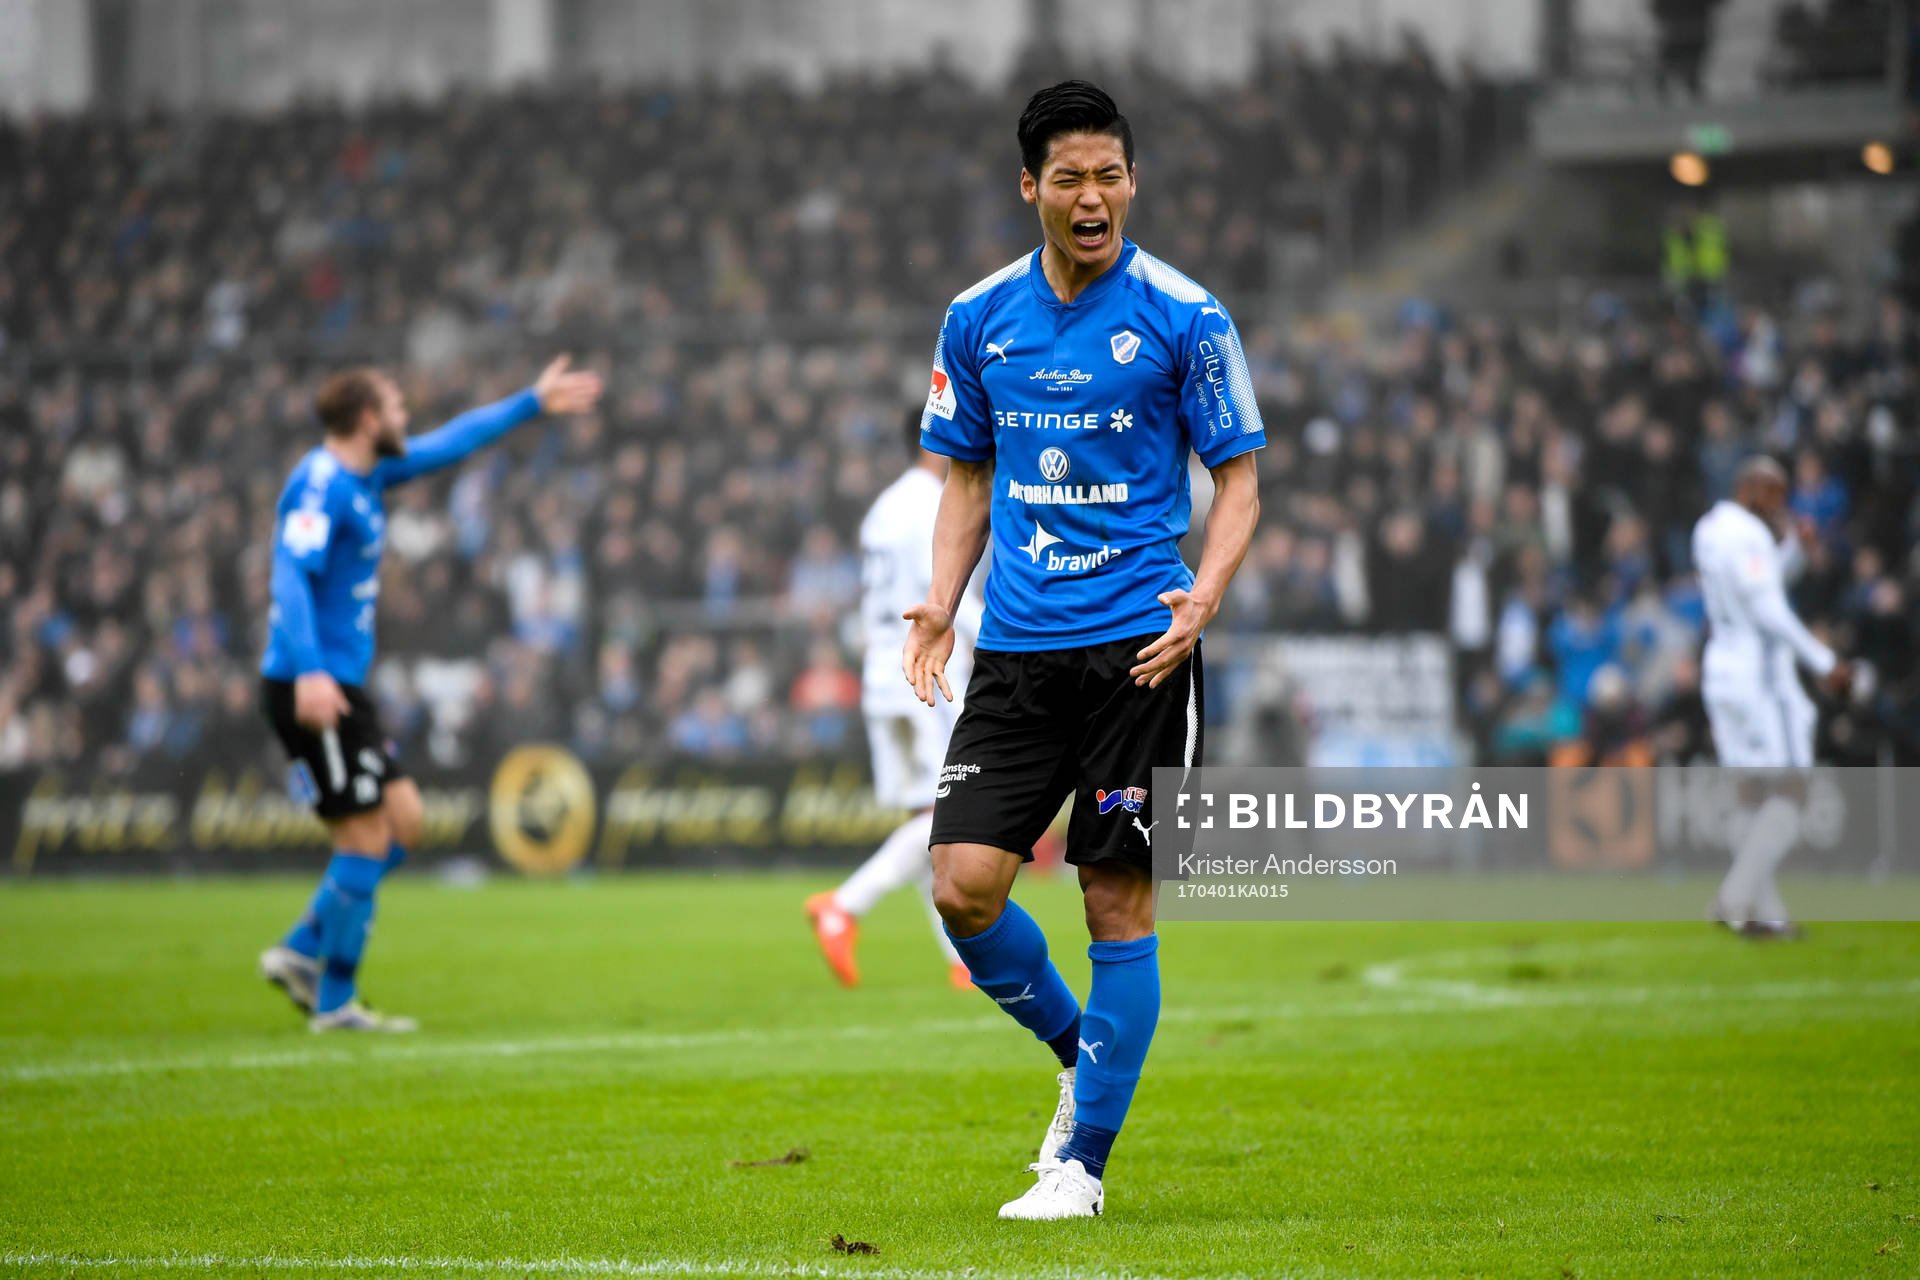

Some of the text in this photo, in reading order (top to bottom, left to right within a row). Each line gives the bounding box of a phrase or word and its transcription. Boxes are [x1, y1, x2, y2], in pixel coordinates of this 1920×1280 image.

[1029, 368, 1093, 384] Anthon Berg
[1198, 340, 1233, 429] cityweb
[935, 403, 951, 415] SPEL
[1008, 479, 1129, 505] MTORHALLAND
